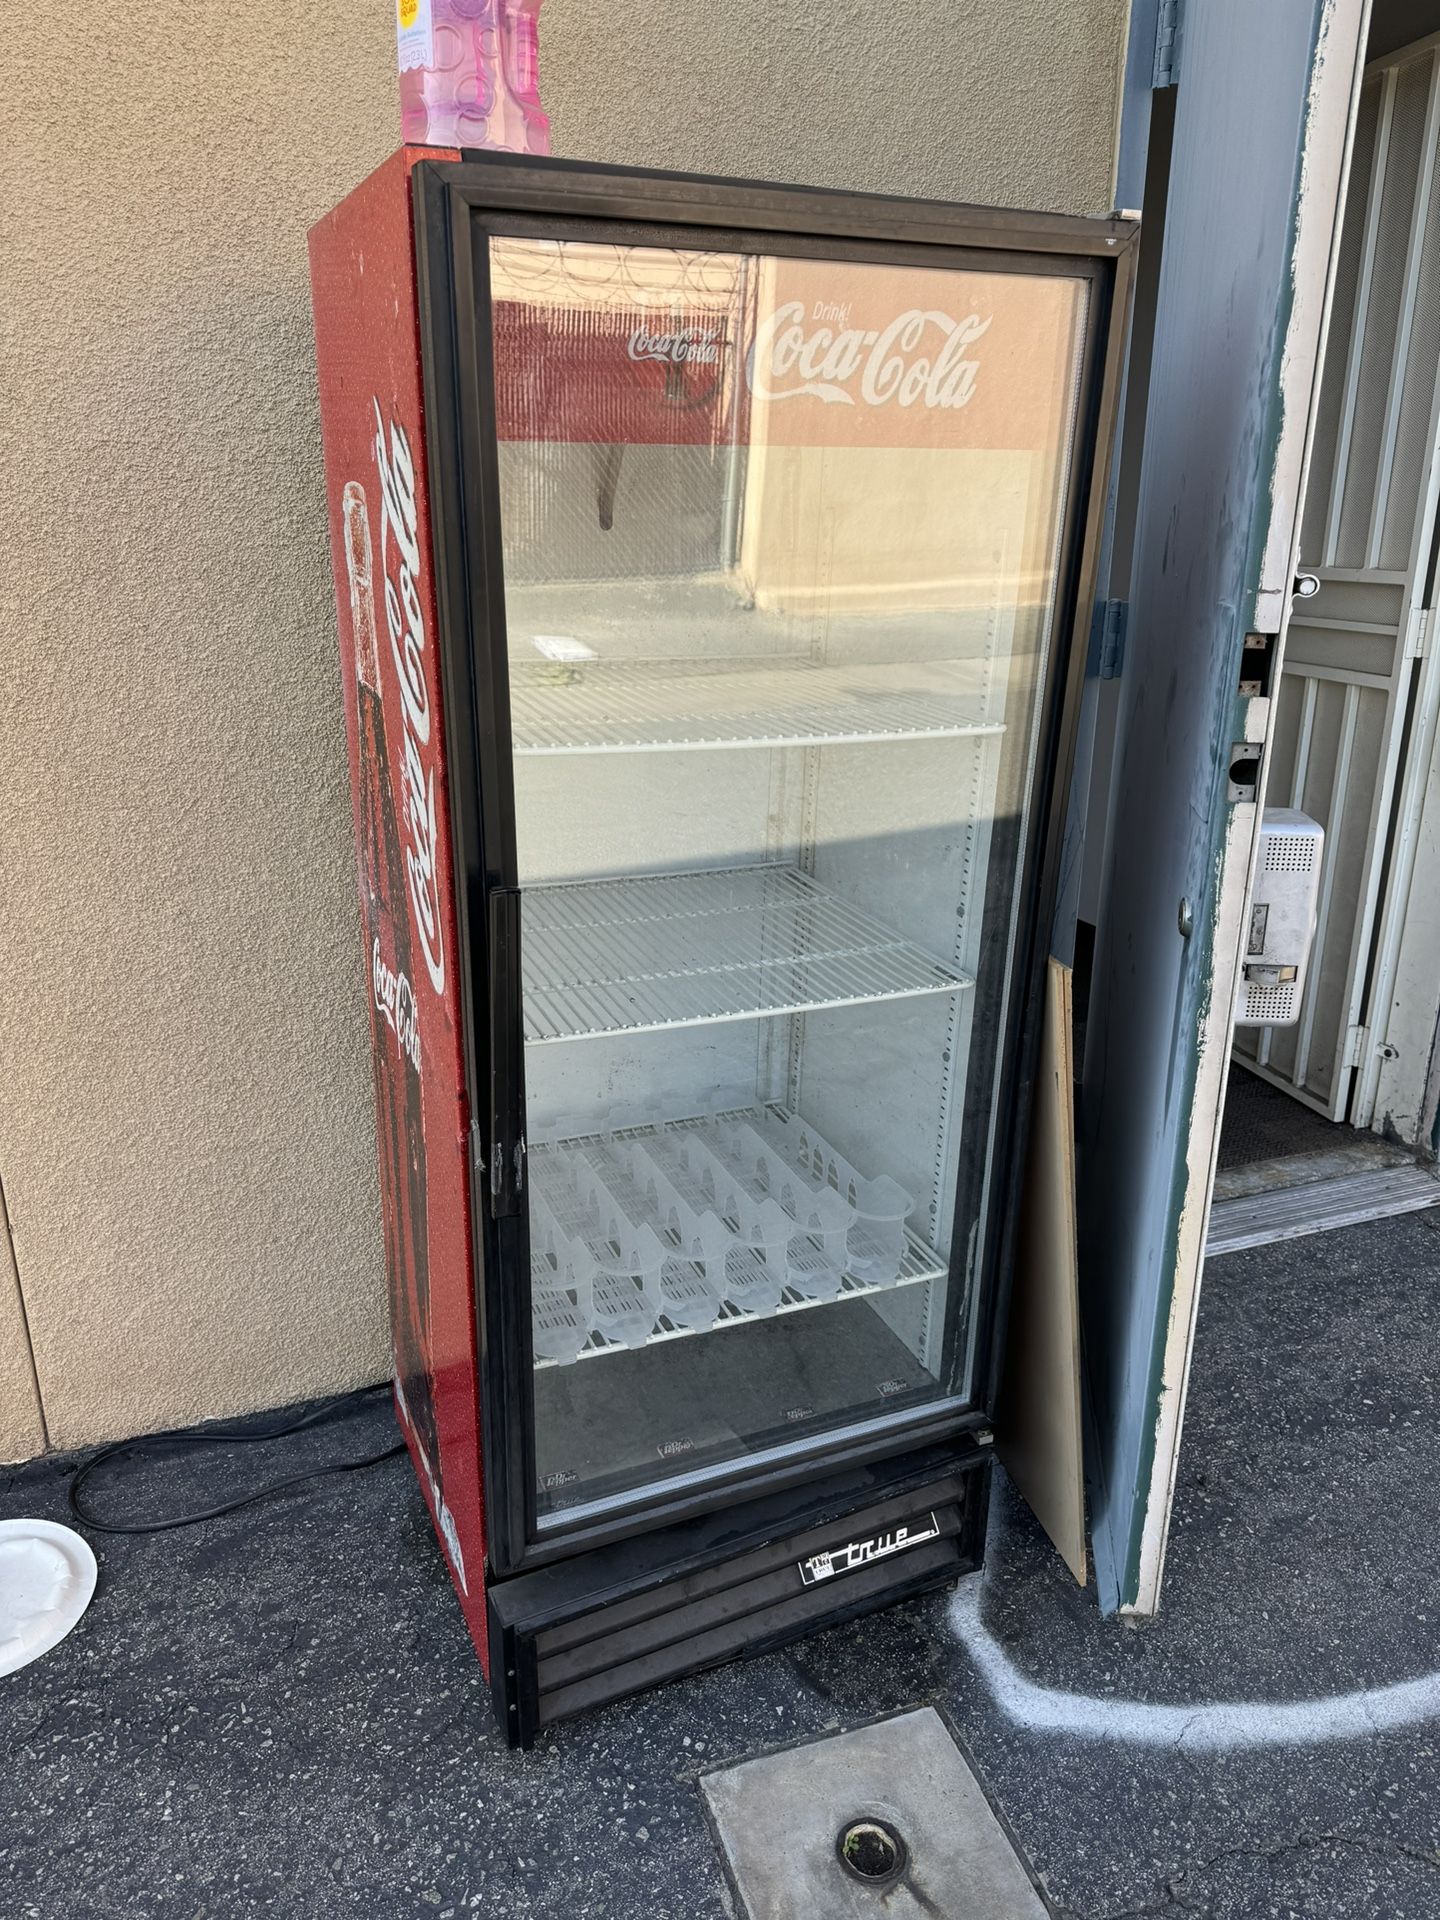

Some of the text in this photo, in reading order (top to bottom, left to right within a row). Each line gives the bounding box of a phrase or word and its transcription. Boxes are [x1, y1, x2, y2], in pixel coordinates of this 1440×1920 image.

[627, 324, 721, 364] Coca-Cola
[746, 301, 993, 409] Coca-Cola
[812, 301, 852, 322] Drink!
[373, 394, 445, 996] Coca-Cola
[373, 937, 422, 1075] Coca-Cola
